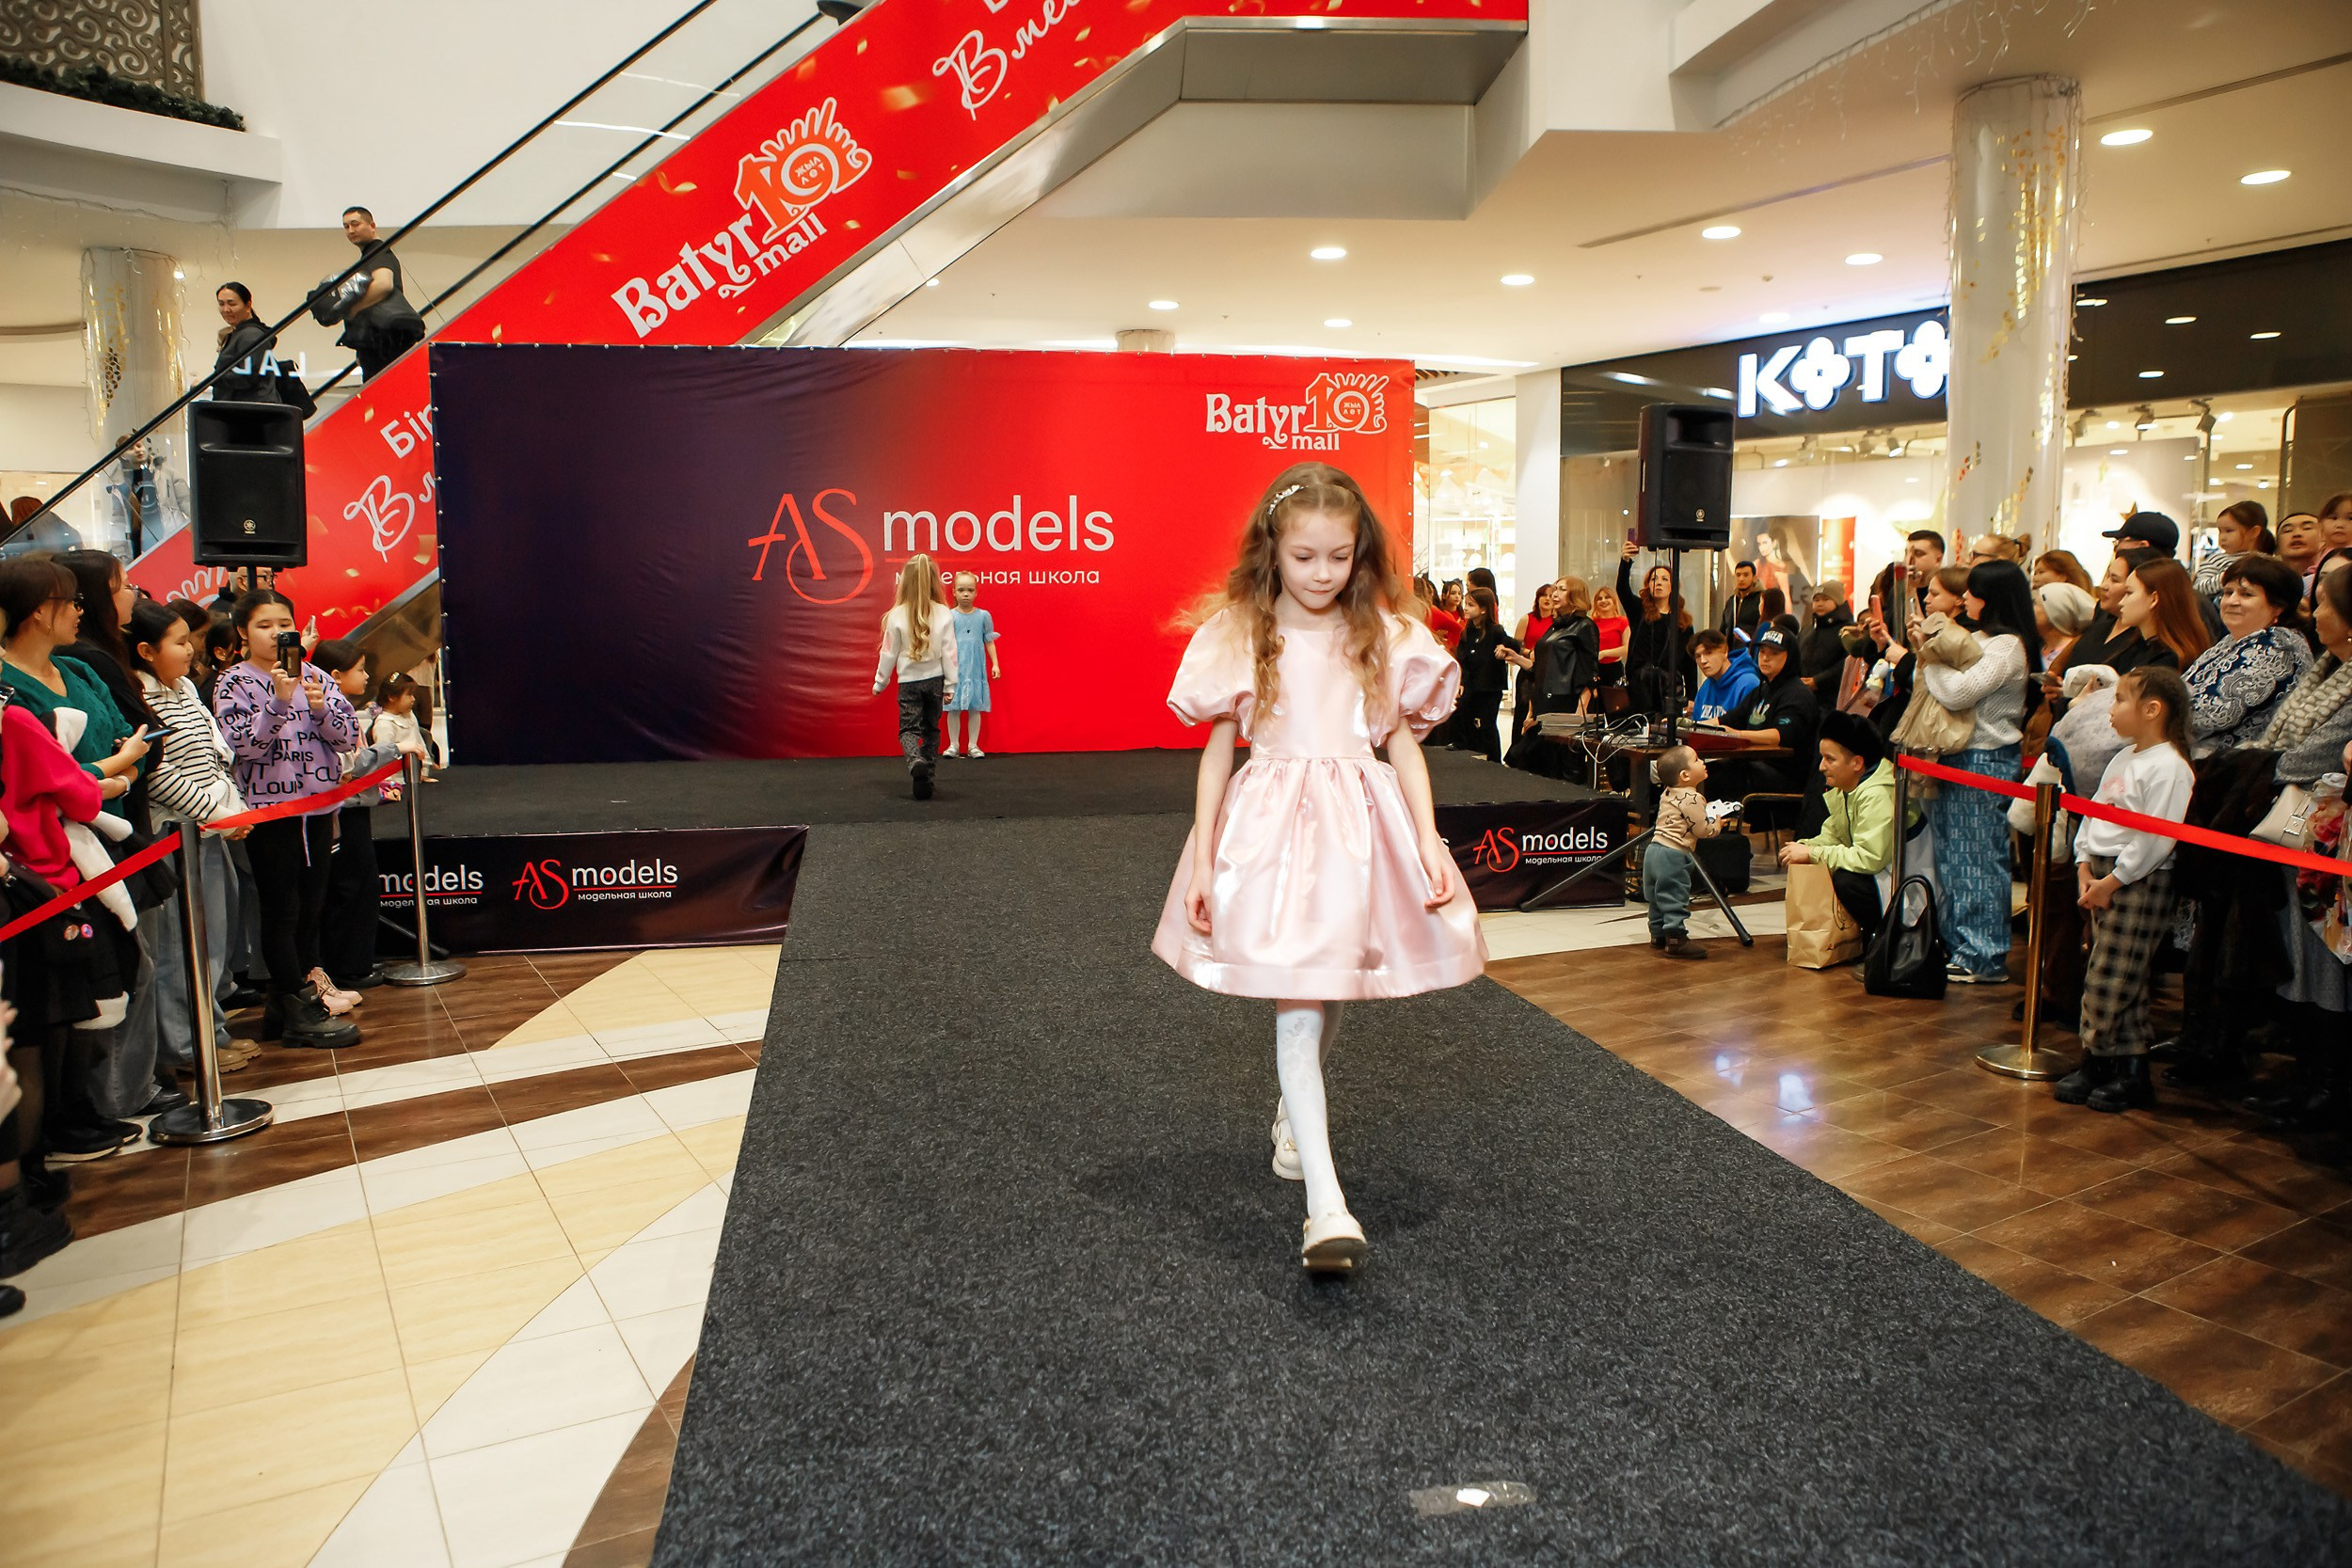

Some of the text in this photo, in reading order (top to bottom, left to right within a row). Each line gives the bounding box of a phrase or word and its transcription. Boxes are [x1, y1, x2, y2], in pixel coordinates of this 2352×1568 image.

[754, 214, 828, 277] mall
[611, 211, 763, 339] Batyr
[1738, 320, 1950, 418] KOTO
[1205, 392, 1308, 449] Batyr
[1292, 433, 1341, 451] mall
[748, 488, 1115, 605] AS models
[1028, 570, 1100, 584] школа
[271, 752, 314, 767] PARIS
[1472, 826, 1608, 873] AS models
[1525, 856, 1572, 865] модельная
[380, 896, 478, 909] моделая школа
[512, 859, 678, 910] AS models
[578, 890, 672, 902] модельная школа
